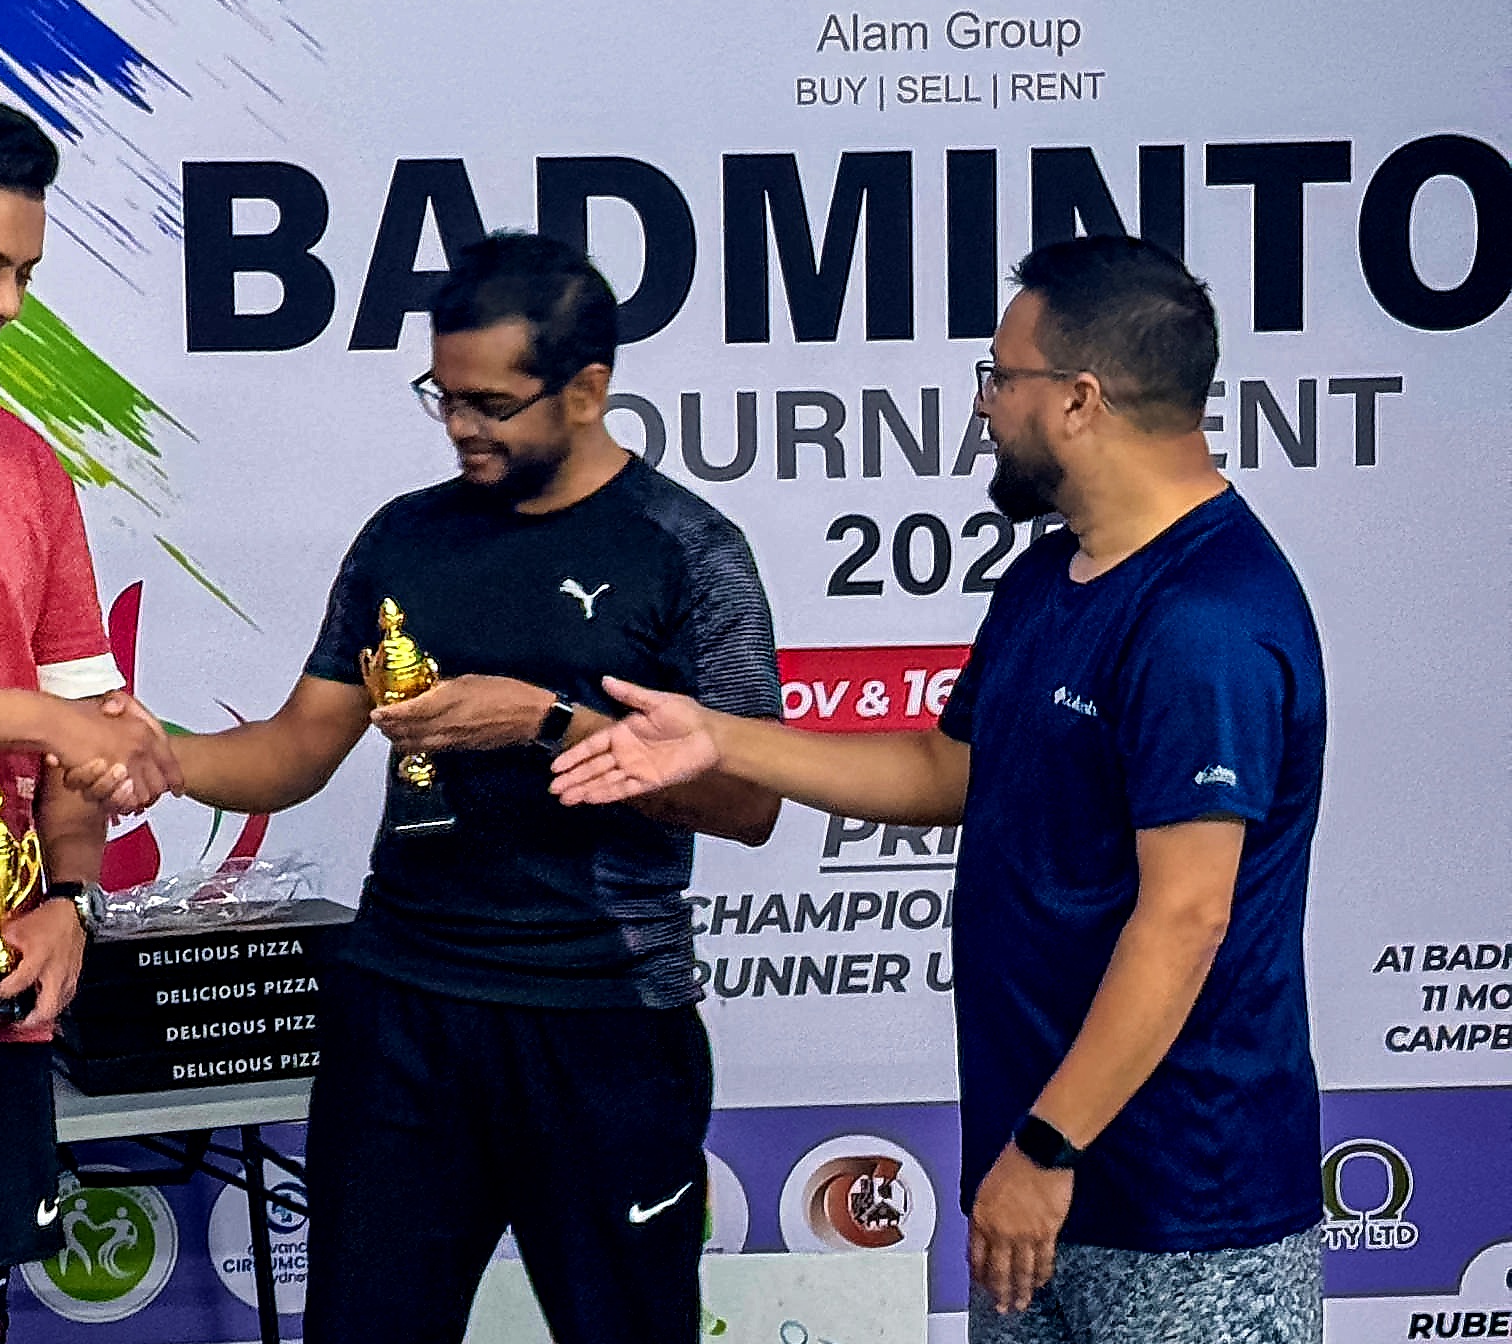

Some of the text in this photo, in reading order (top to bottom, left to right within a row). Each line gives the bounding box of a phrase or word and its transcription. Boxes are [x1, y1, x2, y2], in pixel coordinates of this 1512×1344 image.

[816, 10, 1083, 57] Alam Group
[795, 71, 1106, 107] BUY SELL RENT
[825, 512, 1065, 597] 202
[855, 680, 890, 718] &
[138, 939, 304, 967] DELICIOUS PIZZA
[1372, 944, 1416, 974] A1
[155, 977, 320, 1006] DELICIOUS PIZZA
[165, 1018, 267, 1042] DELICIOUS
[172, 1056, 274, 1080] DELICIOUS
[1369, 1224, 1416, 1246] LTD
